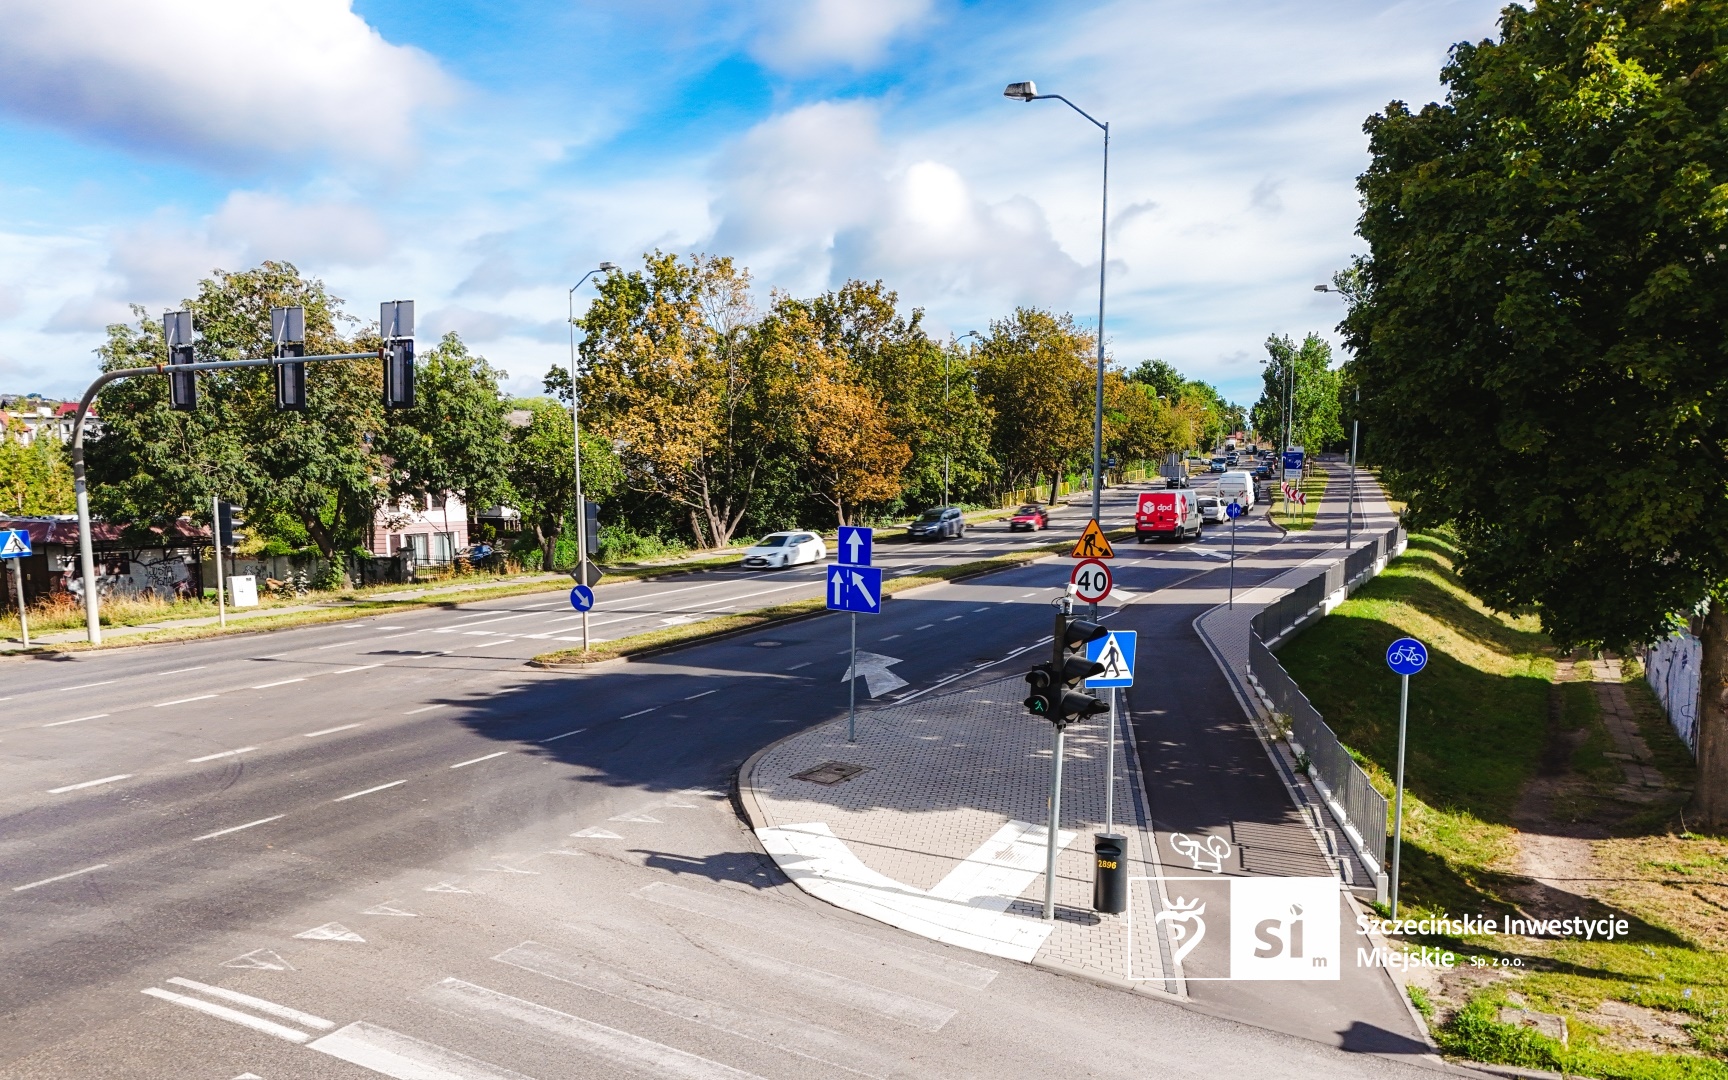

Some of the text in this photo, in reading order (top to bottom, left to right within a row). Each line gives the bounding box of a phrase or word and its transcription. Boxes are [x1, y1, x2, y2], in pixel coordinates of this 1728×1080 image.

[1157, 504, 1173, 512] dpd
[1077, 571, 1107, 592] 40
[1098, 860, 1117, 869] 2896
